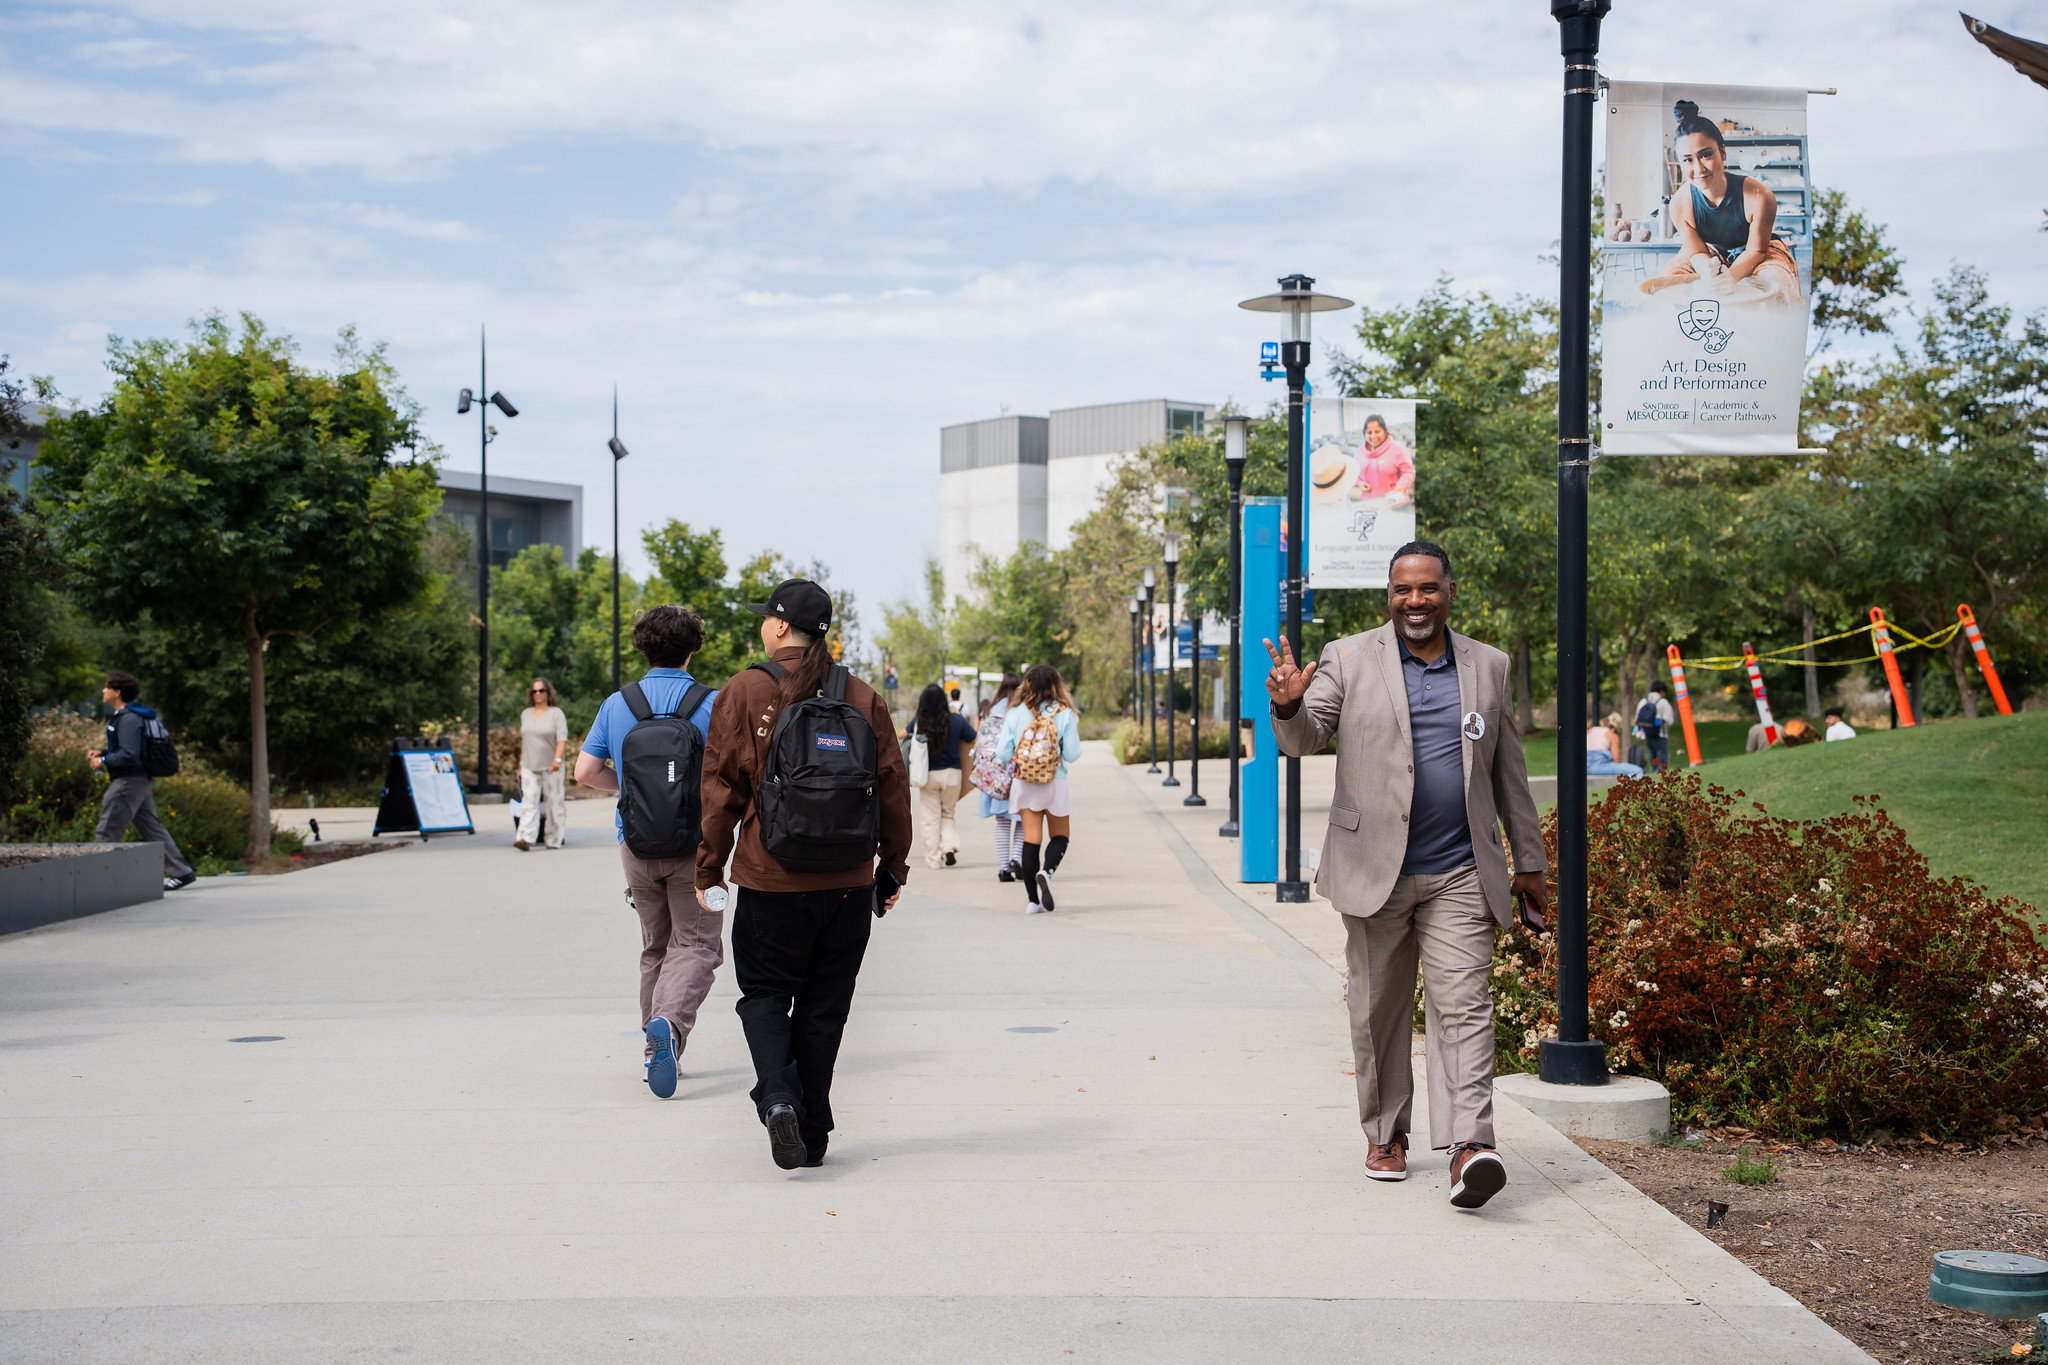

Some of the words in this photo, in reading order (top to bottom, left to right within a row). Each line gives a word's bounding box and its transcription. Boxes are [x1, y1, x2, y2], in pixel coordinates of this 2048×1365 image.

[1661, 359, 1688, 375] Art,
[1695, 359, 1746, 377] Design
[1639, 375, 1668, 390] and
[1673, 375, 1767, 390] Performance
[1642, 402, 1657, 410] SAN
[1657, 402, 1680, 410] DIEGO
[1700, 400, 1749, 410] Academic
[1751, 400, 1760, 410] &
[1700, 411, 1731, 421] Career
[1734, 411, 1777, 423] Pathways
[1315, 544, 1352, 553] Language
[1354, 544, 1370, 552] and
